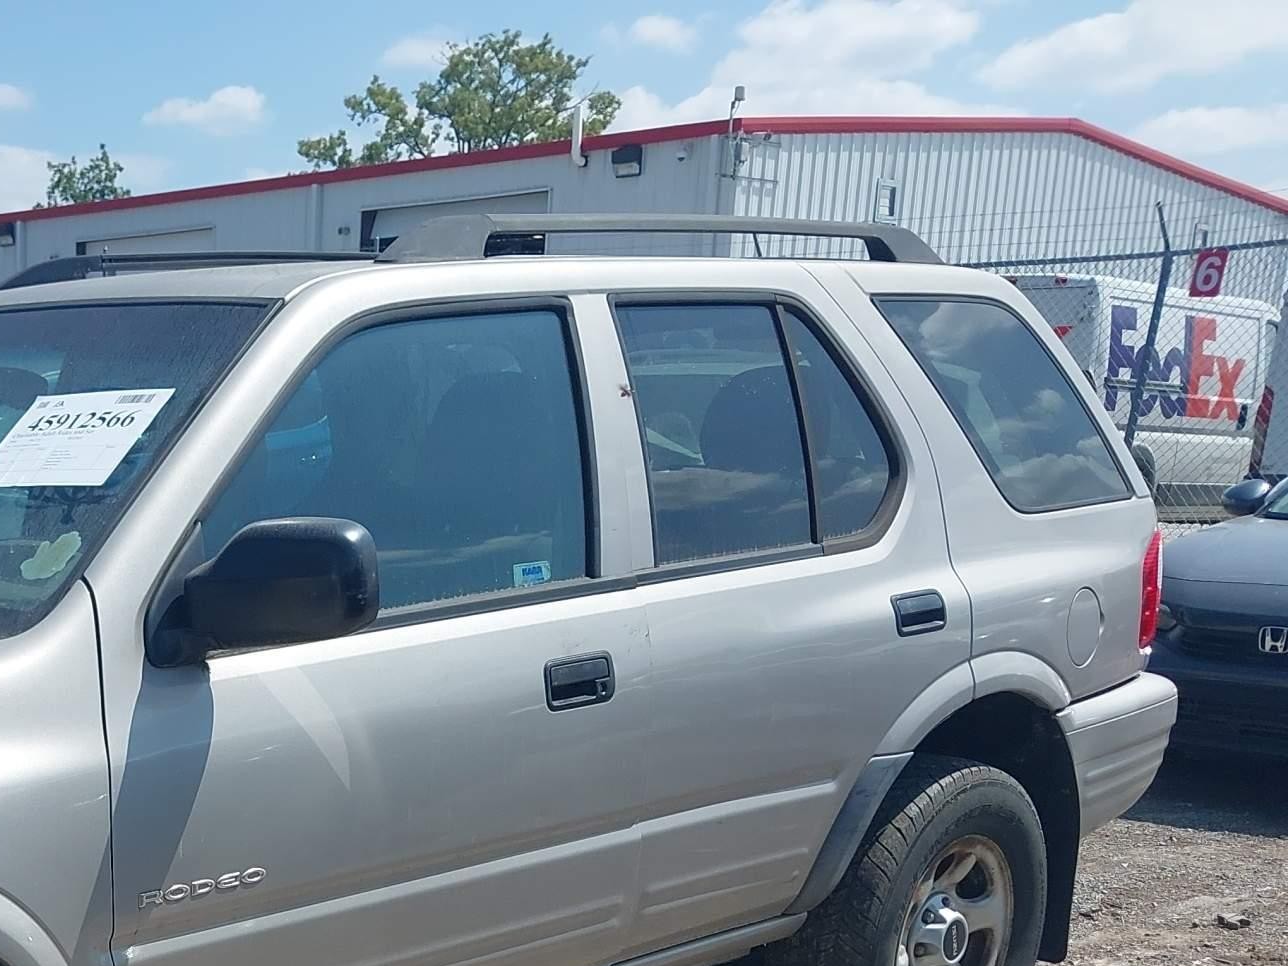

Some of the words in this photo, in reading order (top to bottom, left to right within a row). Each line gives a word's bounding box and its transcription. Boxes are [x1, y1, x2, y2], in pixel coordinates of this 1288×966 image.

[1195, 256, 1223, 291] 6
[1104, 305, 1246, 421] FedEx
[28, 409, 143, 432] 45912566
[138, 867, 267, 907] RODEO
